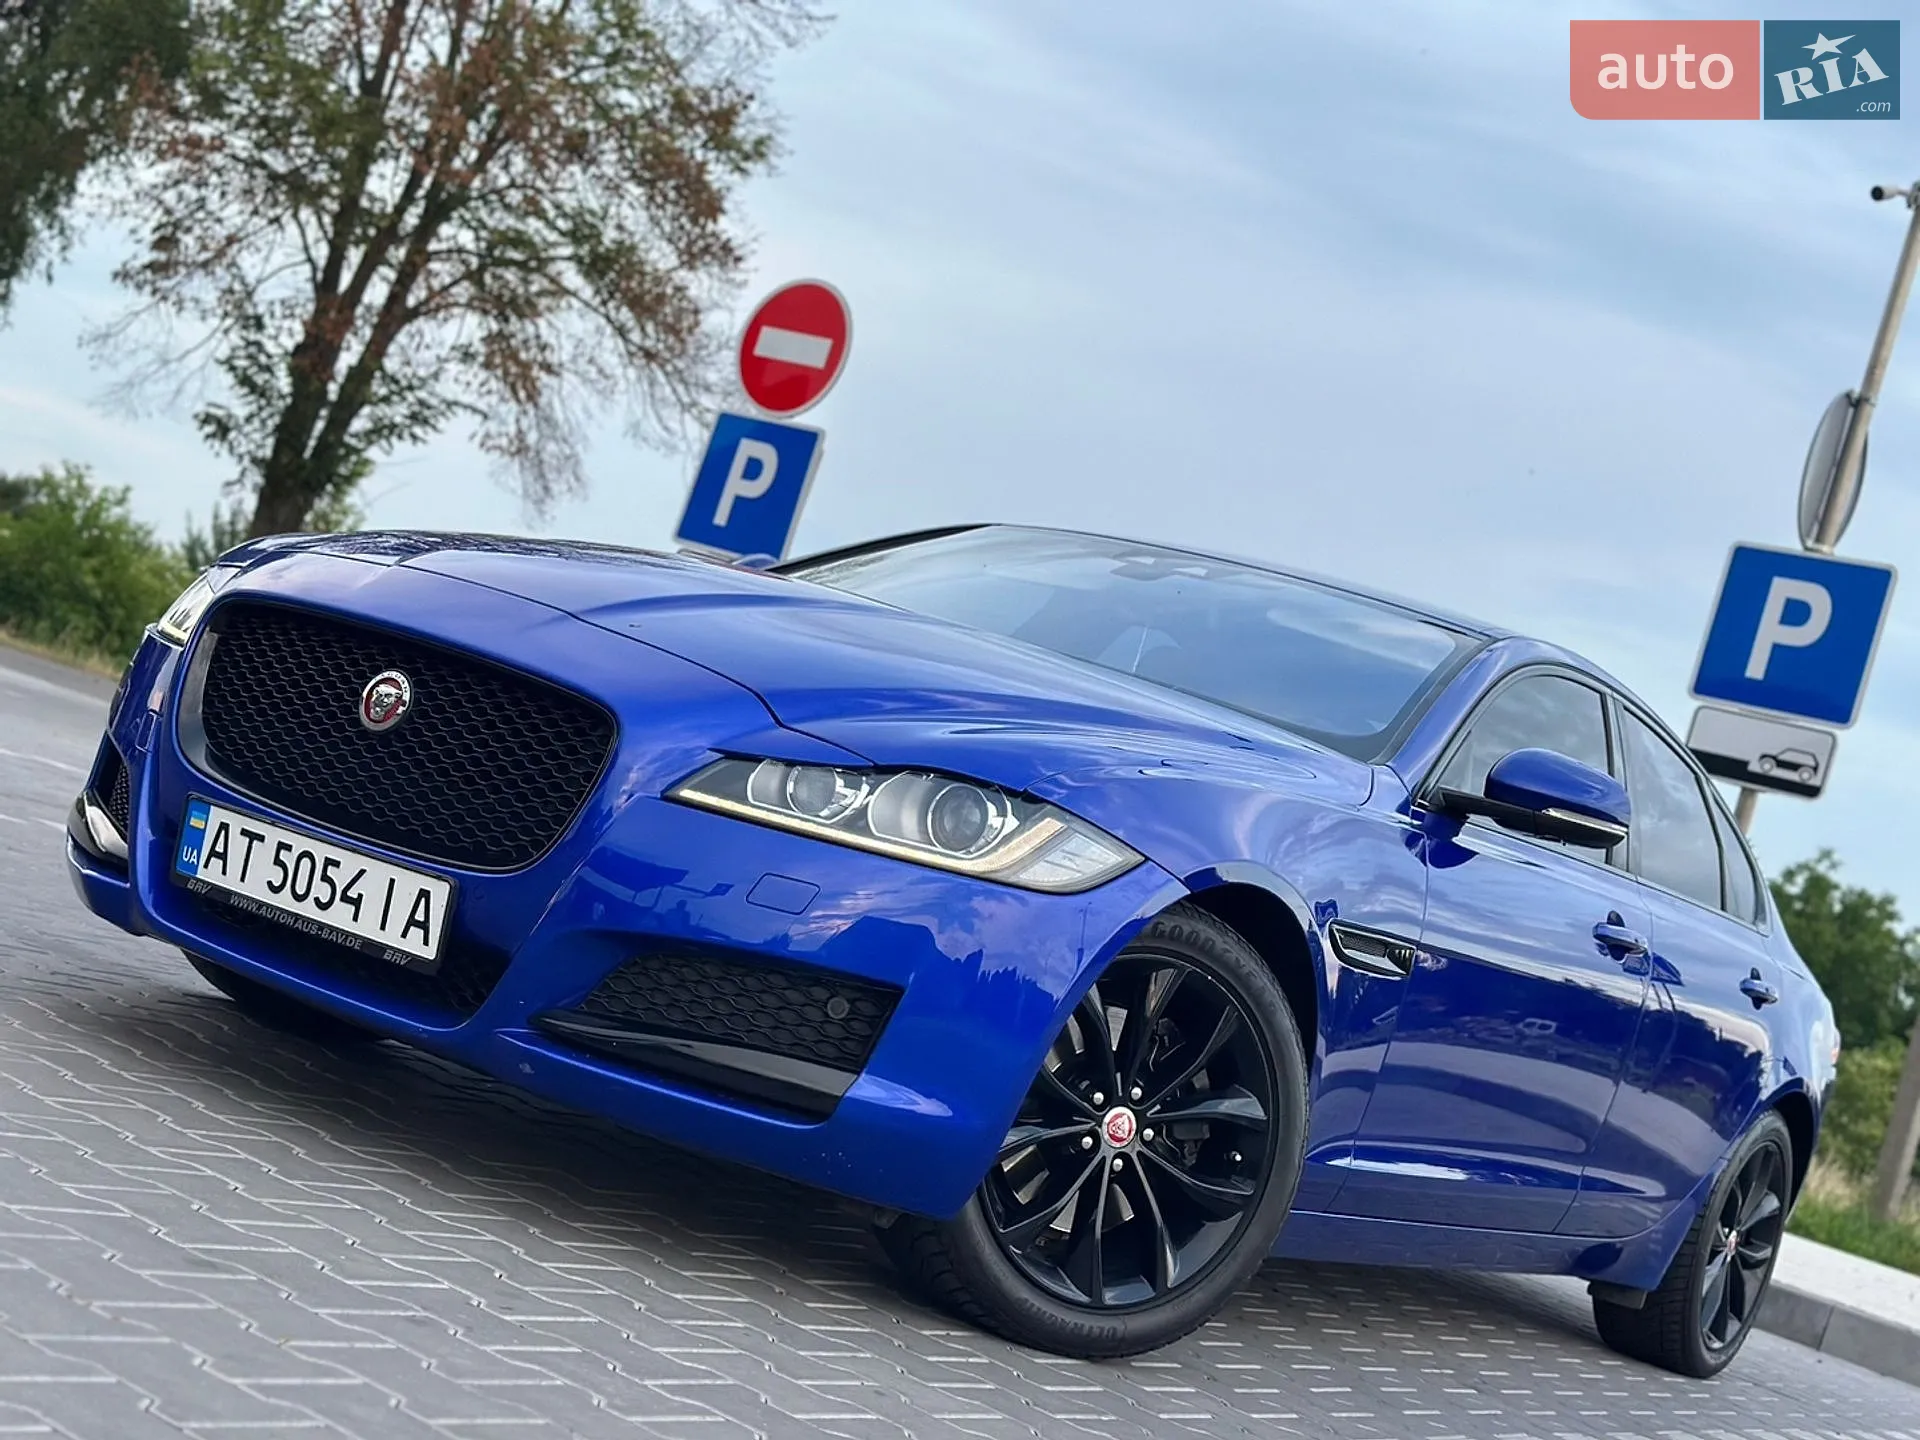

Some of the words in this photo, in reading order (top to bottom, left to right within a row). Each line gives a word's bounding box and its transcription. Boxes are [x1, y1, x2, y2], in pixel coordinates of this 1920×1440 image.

[712, 437, 780, 528] P
[1744, 576, 1833, 681] P
[182, 845, 199, 866] UA
[203, 821, 266, 883] AT
[266, 840, 367, 923] 5054
[379, 877, 433, 947] IA
